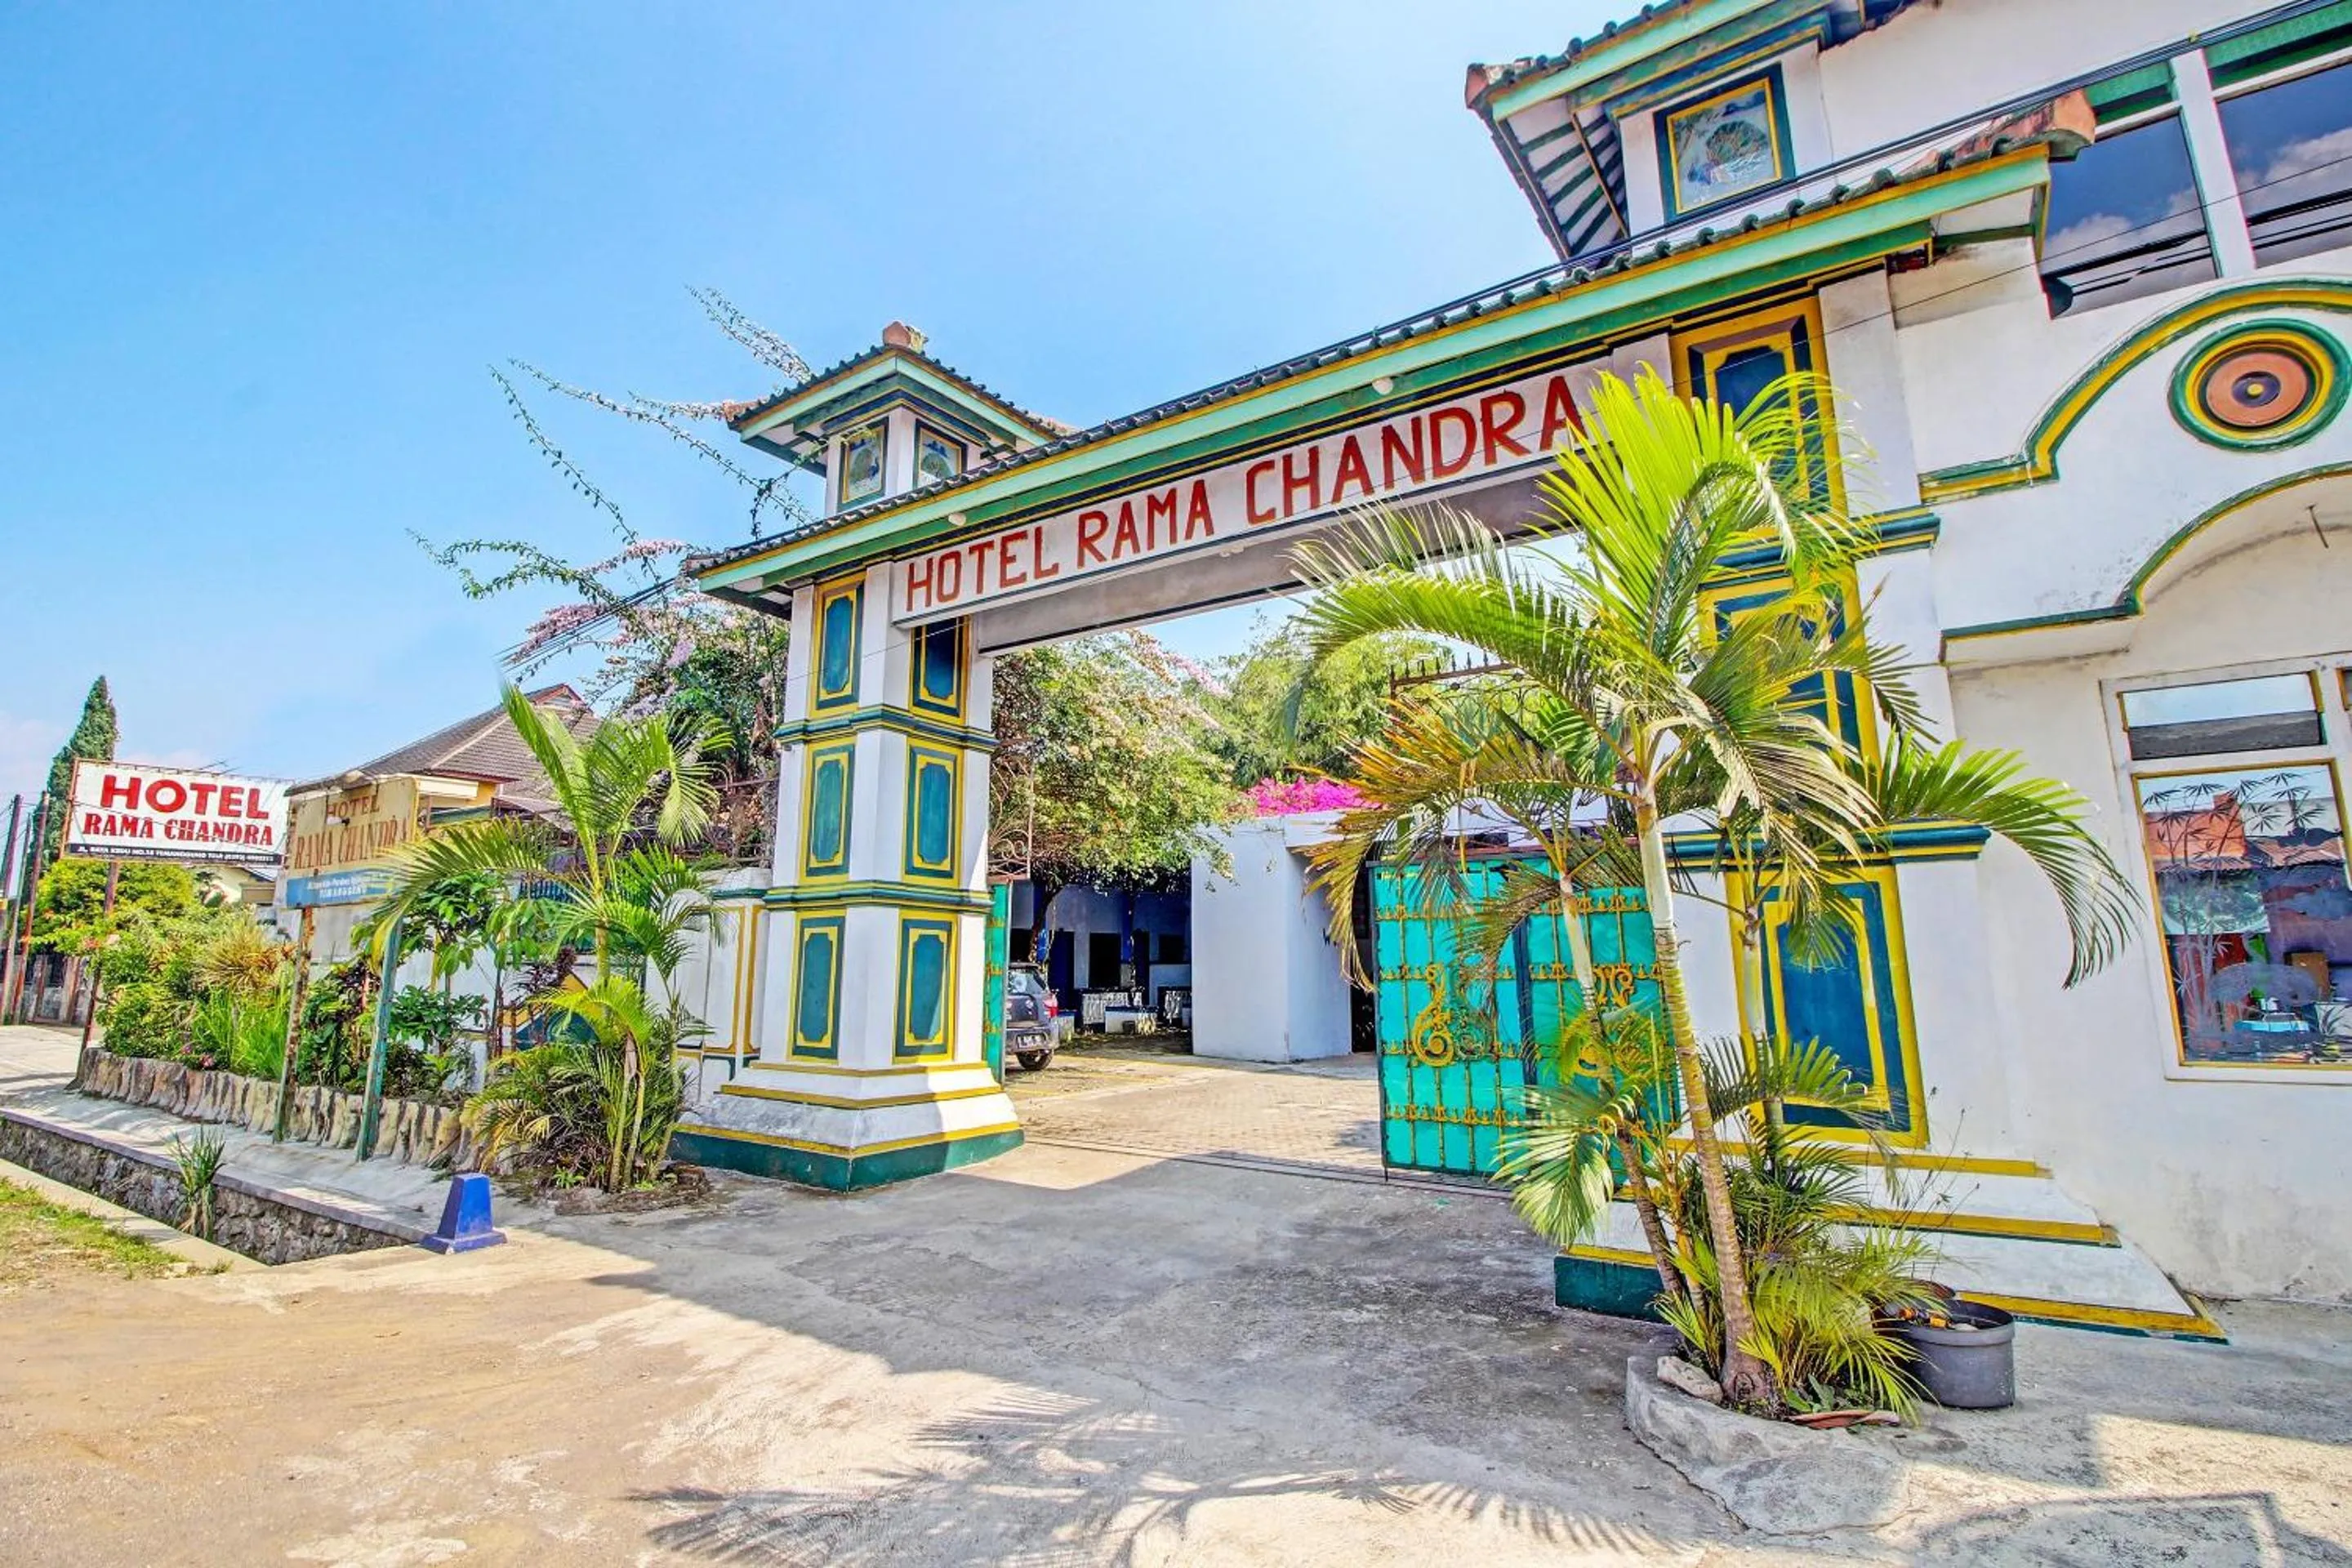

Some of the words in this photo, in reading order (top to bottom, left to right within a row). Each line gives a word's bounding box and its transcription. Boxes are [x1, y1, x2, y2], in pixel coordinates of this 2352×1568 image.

[906, 527, 1058, 612] HOTEL
[1076, 479, 1214, 568] RAMA
[1245, 376, 1588, 525] CHANDRA
[100, 775, 269, 819] HOTEL
[327, 795, 379, 817] HOTEL
[82, 813, 154, 839] RAMA
[164, 818, 272, 846] CHANDRA
[295, 831, 331, 869] RAMA
